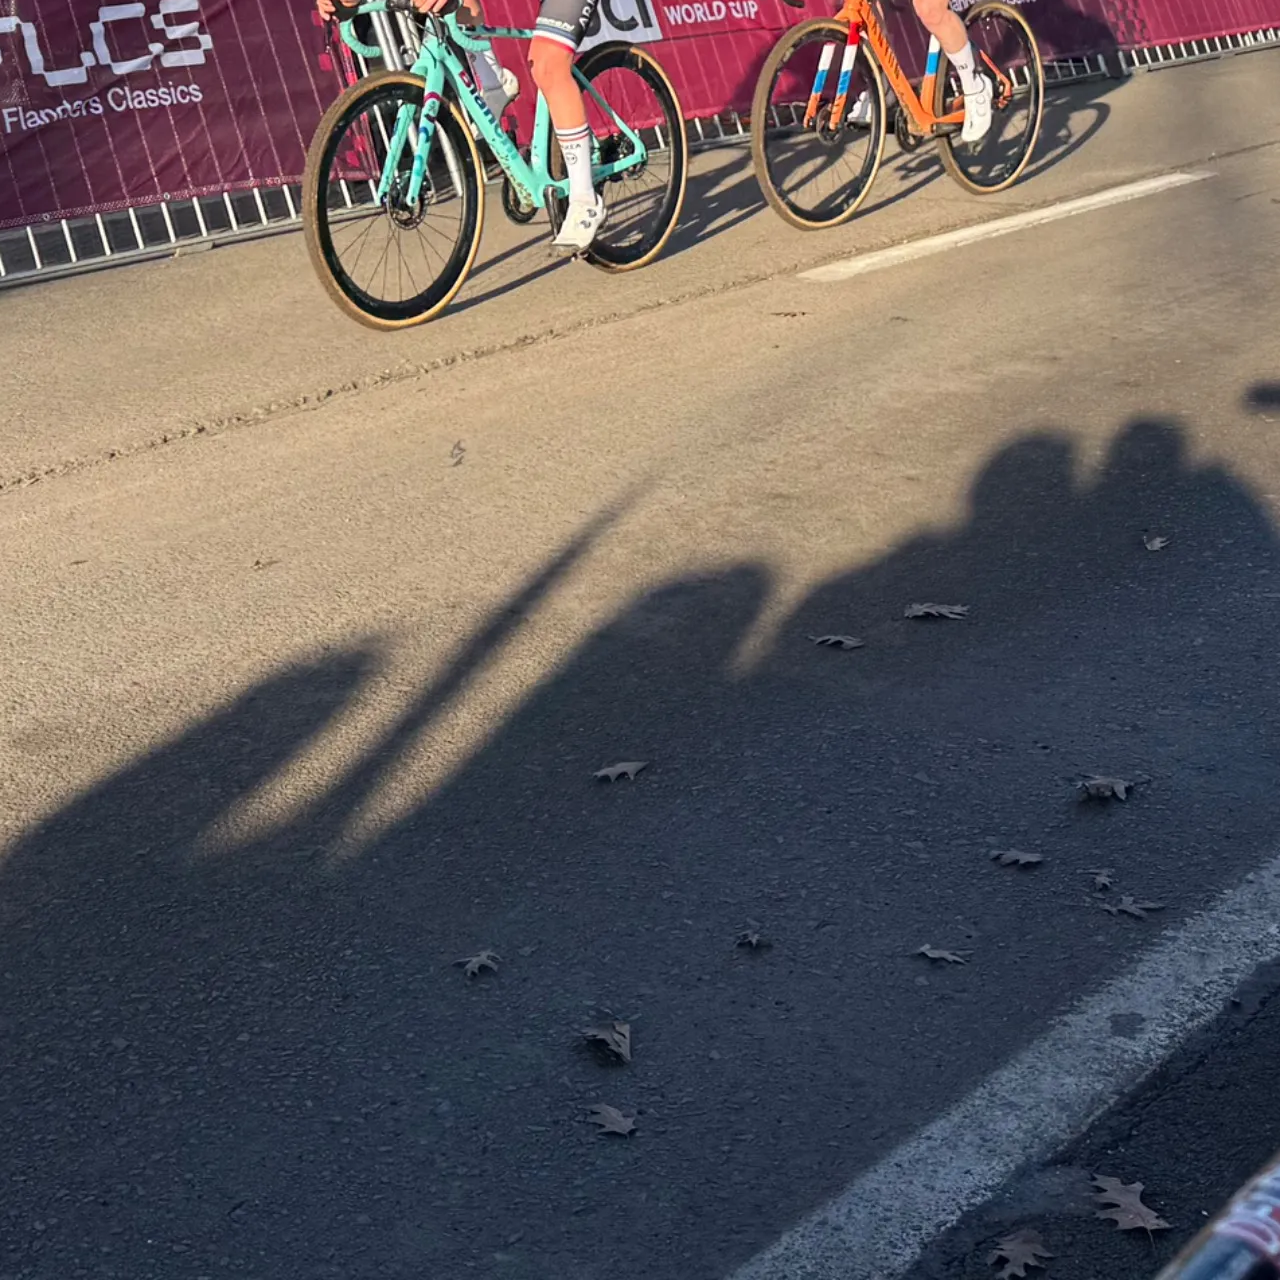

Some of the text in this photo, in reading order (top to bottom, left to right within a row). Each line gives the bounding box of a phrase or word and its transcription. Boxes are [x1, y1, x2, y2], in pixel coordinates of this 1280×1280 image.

[663, 0, 759, 26] WORLD CUP
[2, 82, 204, 134] Flanders Classics
